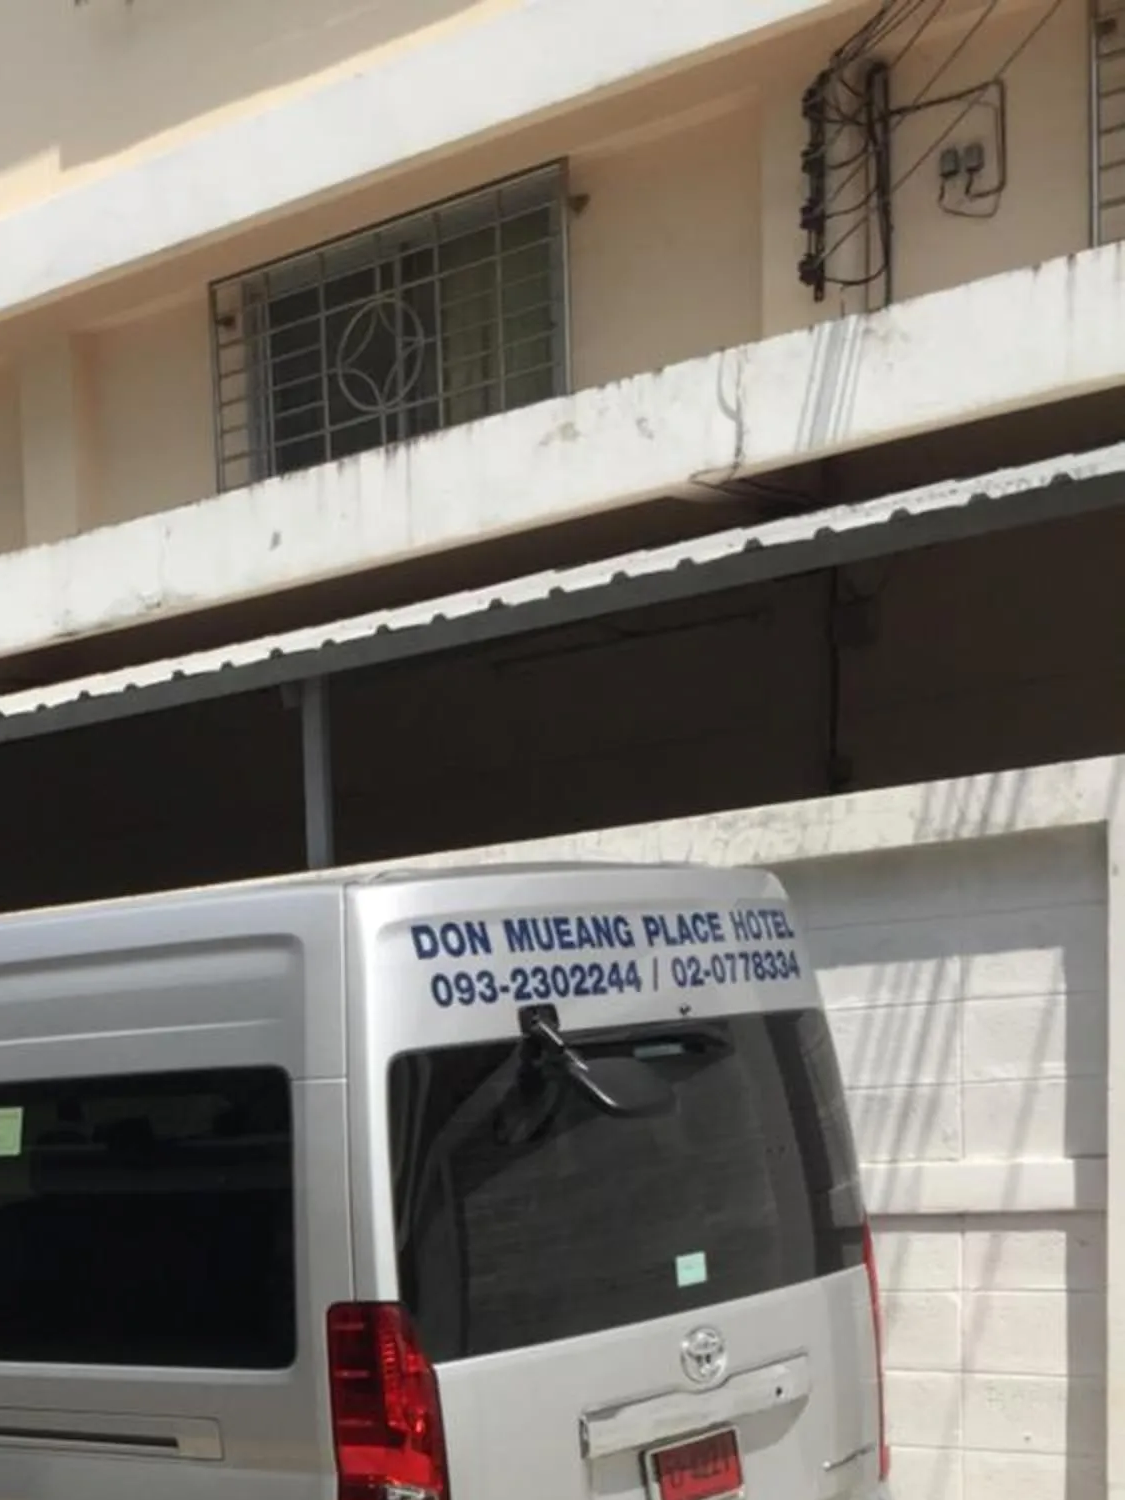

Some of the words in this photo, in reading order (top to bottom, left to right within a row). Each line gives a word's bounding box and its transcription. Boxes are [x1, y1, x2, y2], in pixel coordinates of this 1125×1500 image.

[411, 923, 492, 960] DON
[503, 914, 635, 953] MUEANG
[643, 911, 725, 948] PLACE
[729, 909, 795, 941] HOTEL
[431, 961, 642, 1008] 093-2302244
[671, 951, 801, 988] 02-0778334
